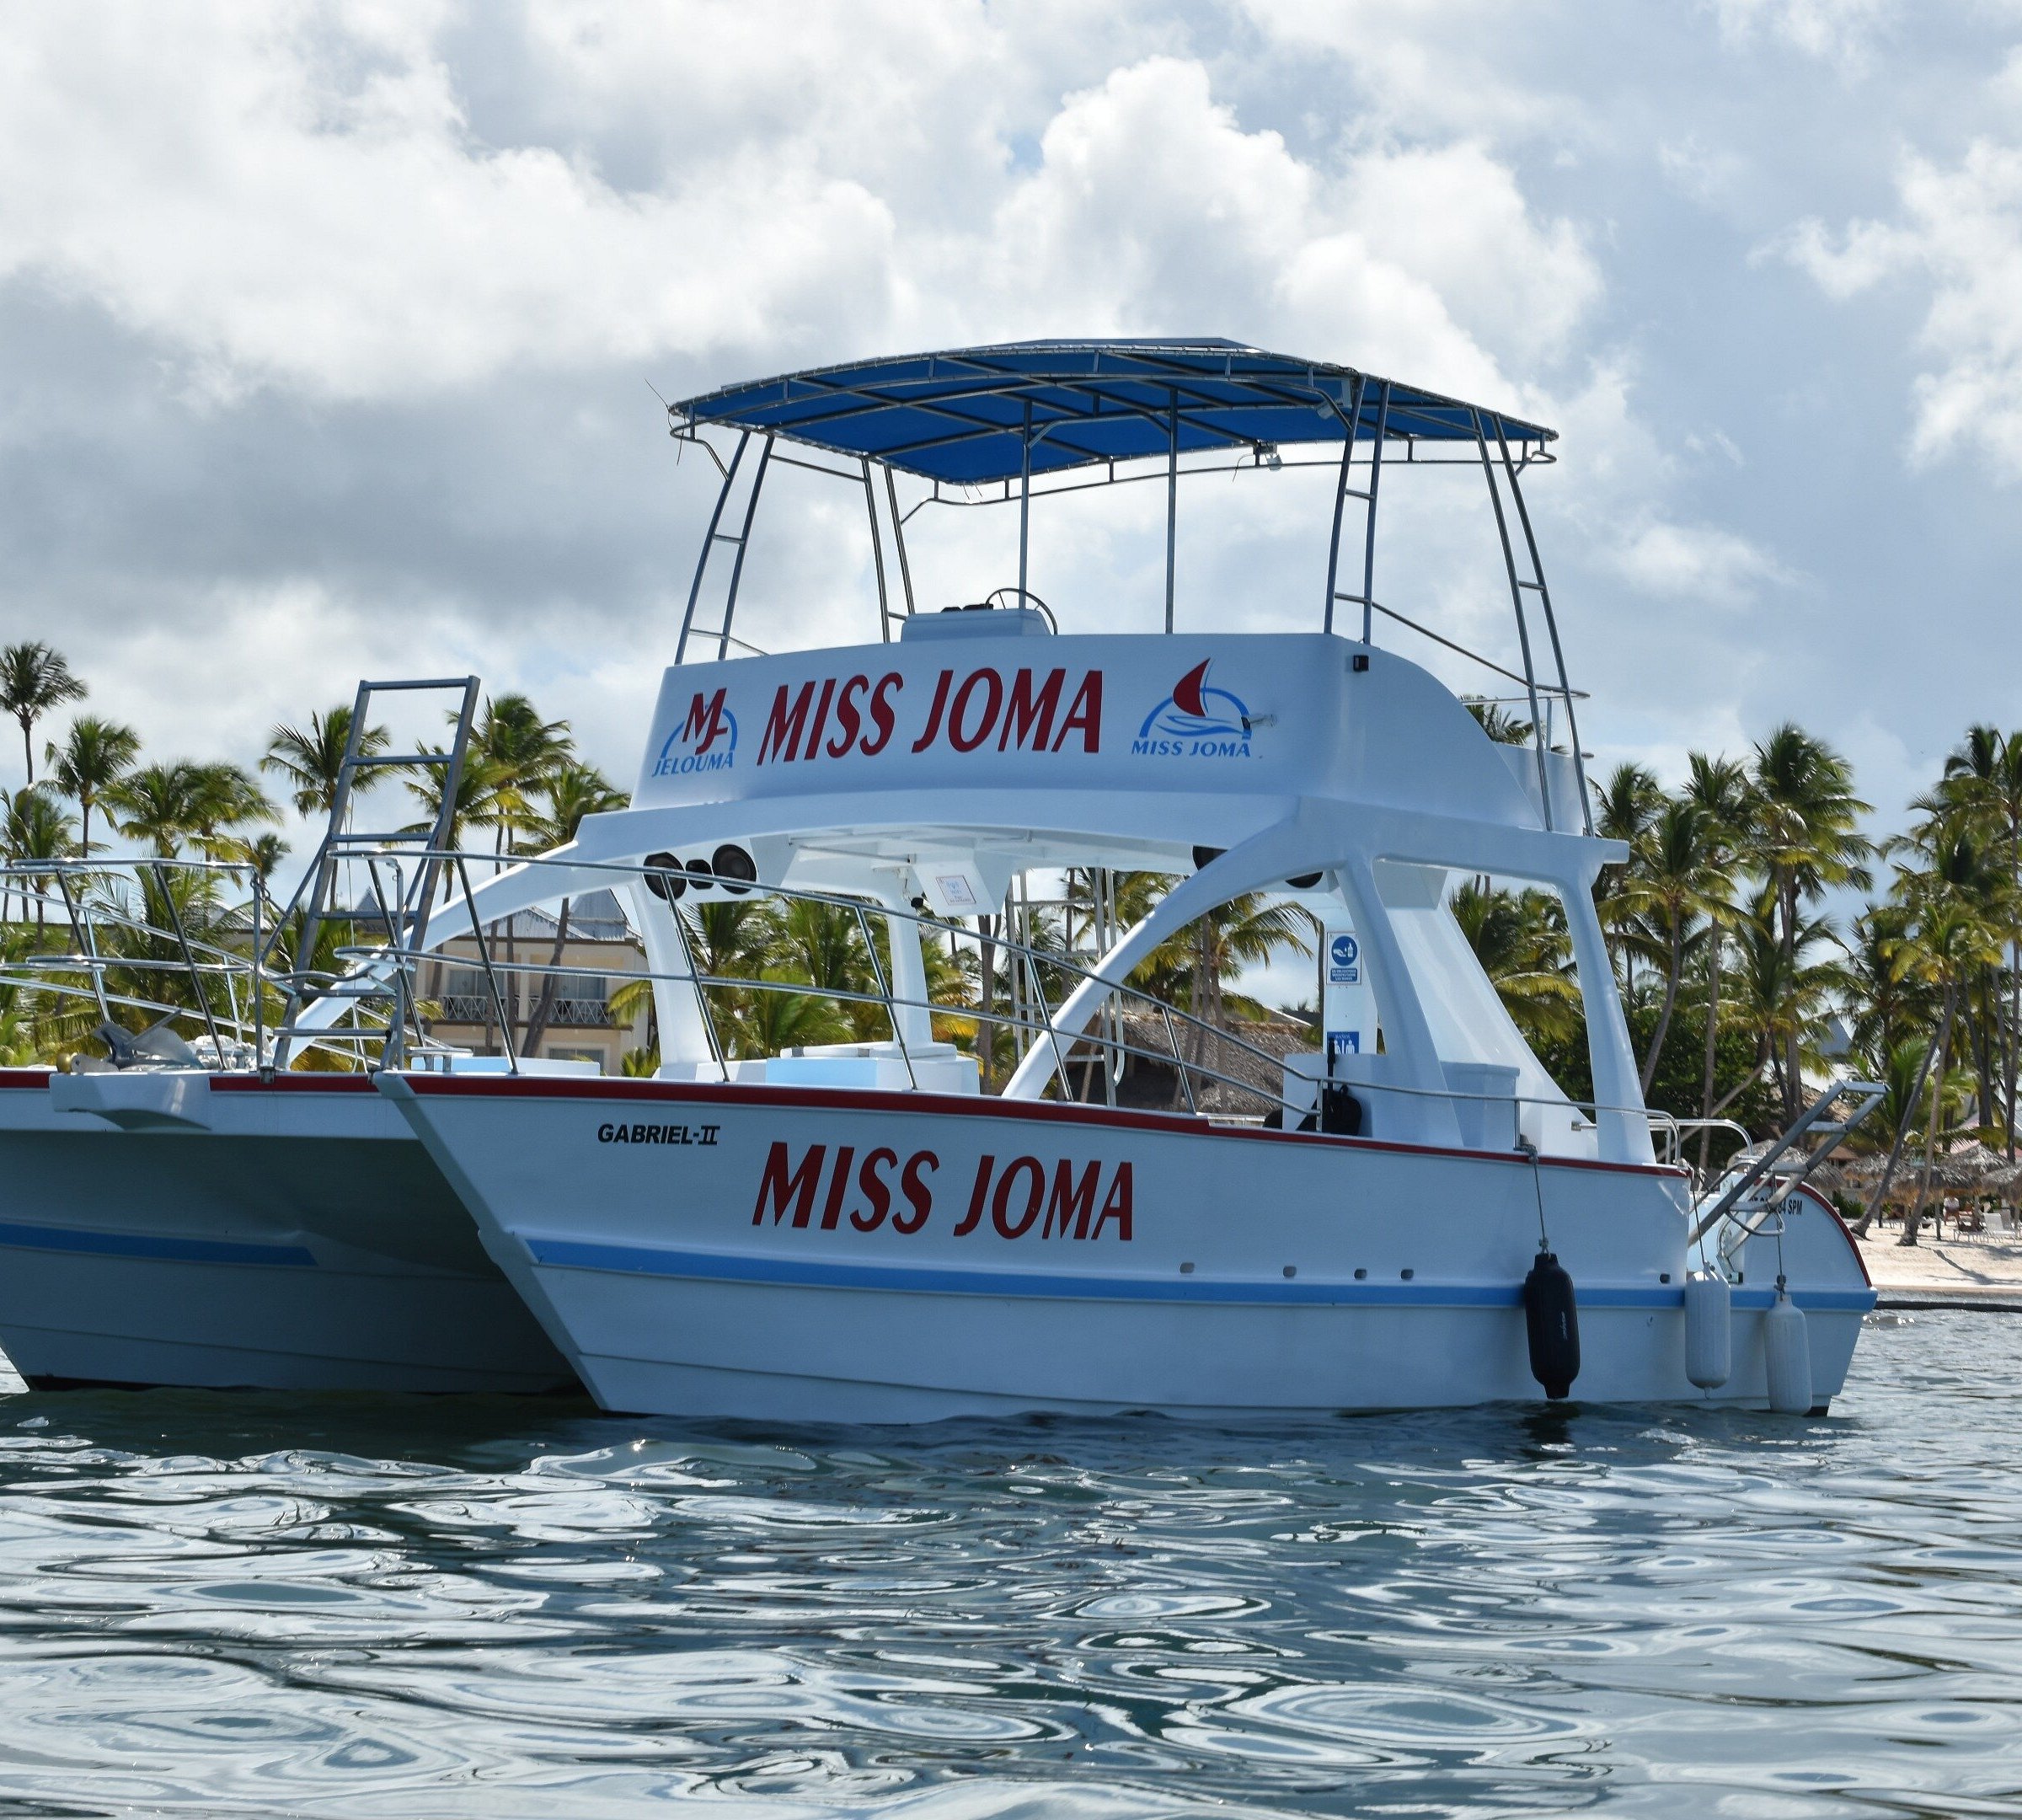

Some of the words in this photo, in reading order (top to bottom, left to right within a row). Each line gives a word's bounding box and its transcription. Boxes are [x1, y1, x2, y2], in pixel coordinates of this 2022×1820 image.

[757, 672, 905, 767] MISS
[911, 667, 1103, 755] JOMA
[1131, 740, 1183, 756] MISS
[1189, 741, 1251, 757] JOMA
[651, 752, 733, 777] JELOUMA
[597, 1123, 721, 1146] GABRIEL-II
[752, 1142, 940, 1234] MISS
[953, 1155, 1133, 1241] JOMA
[1788, 1199, 1803, 1215] SPM
